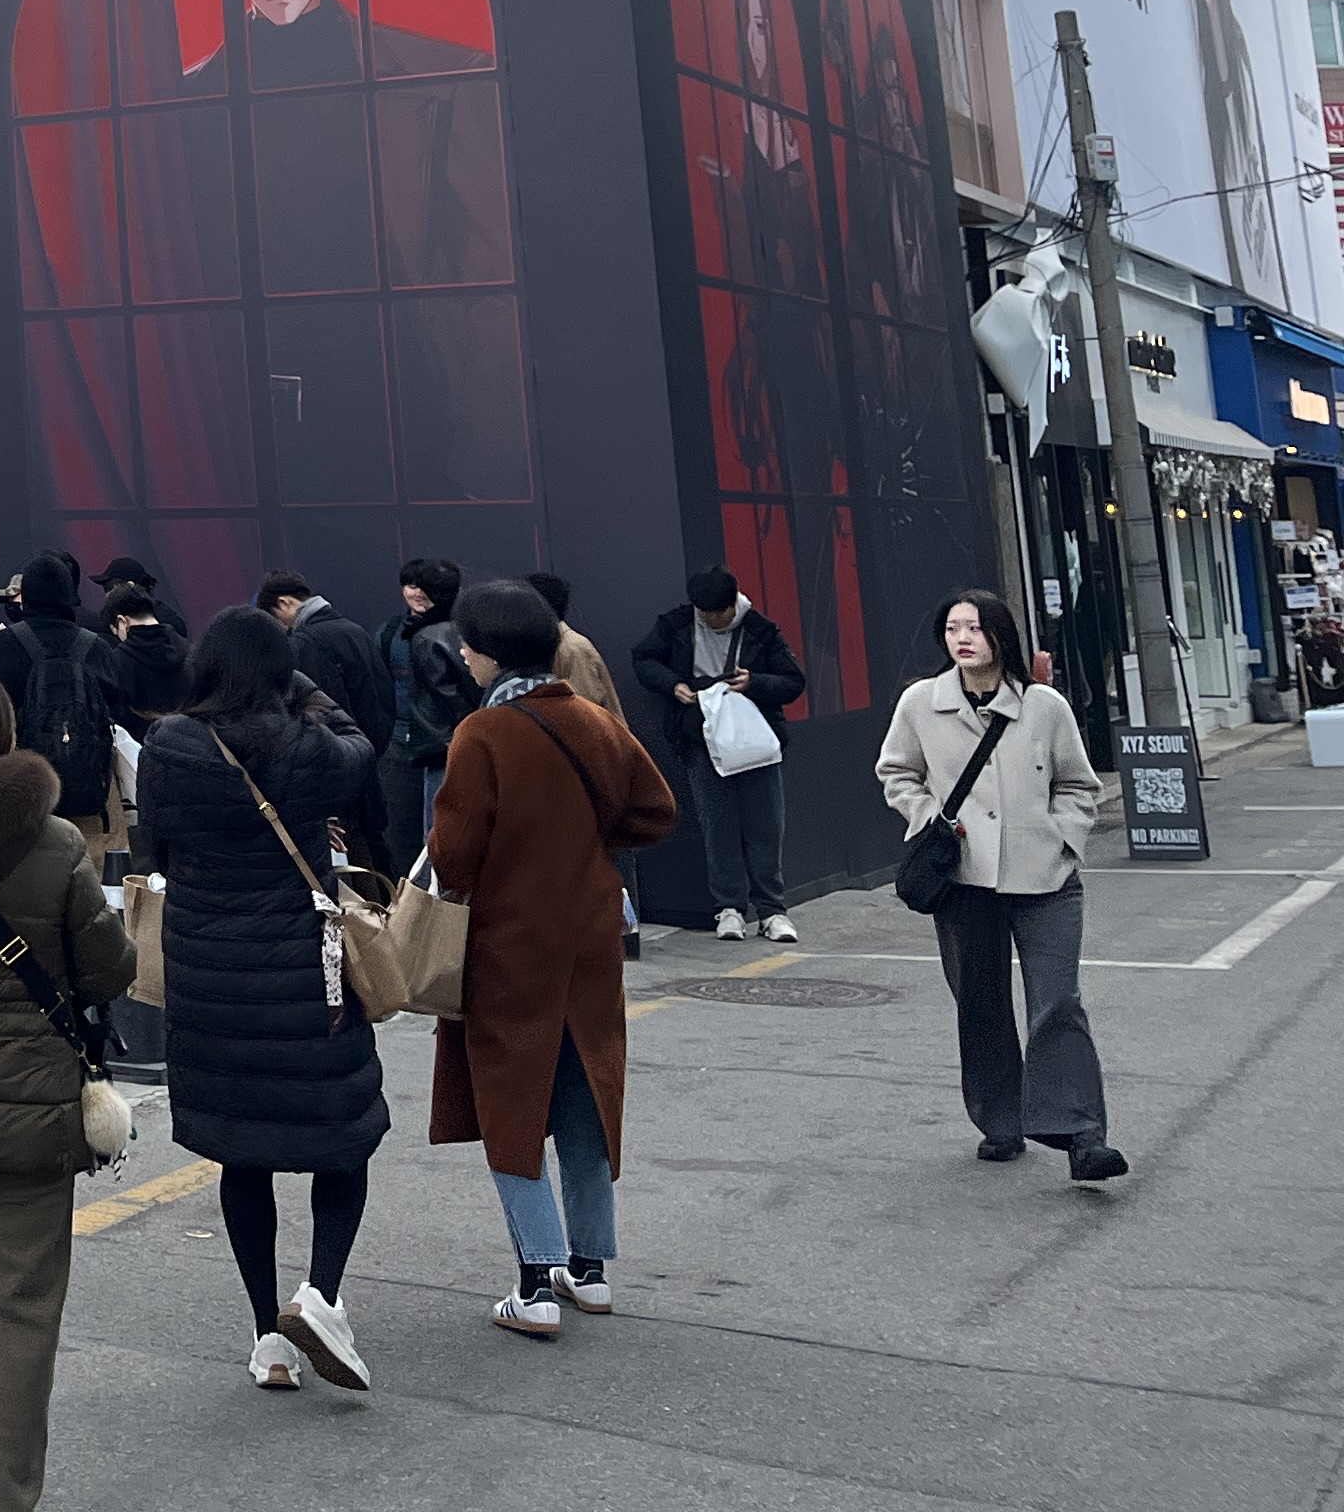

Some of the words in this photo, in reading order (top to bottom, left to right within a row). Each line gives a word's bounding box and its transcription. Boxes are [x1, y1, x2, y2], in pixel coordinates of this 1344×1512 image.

[1121, 735, 1146, 754] XYZ
[1148, 735, 1188, 754] SEOUL
[1131, 828, 1147, 843] NO
